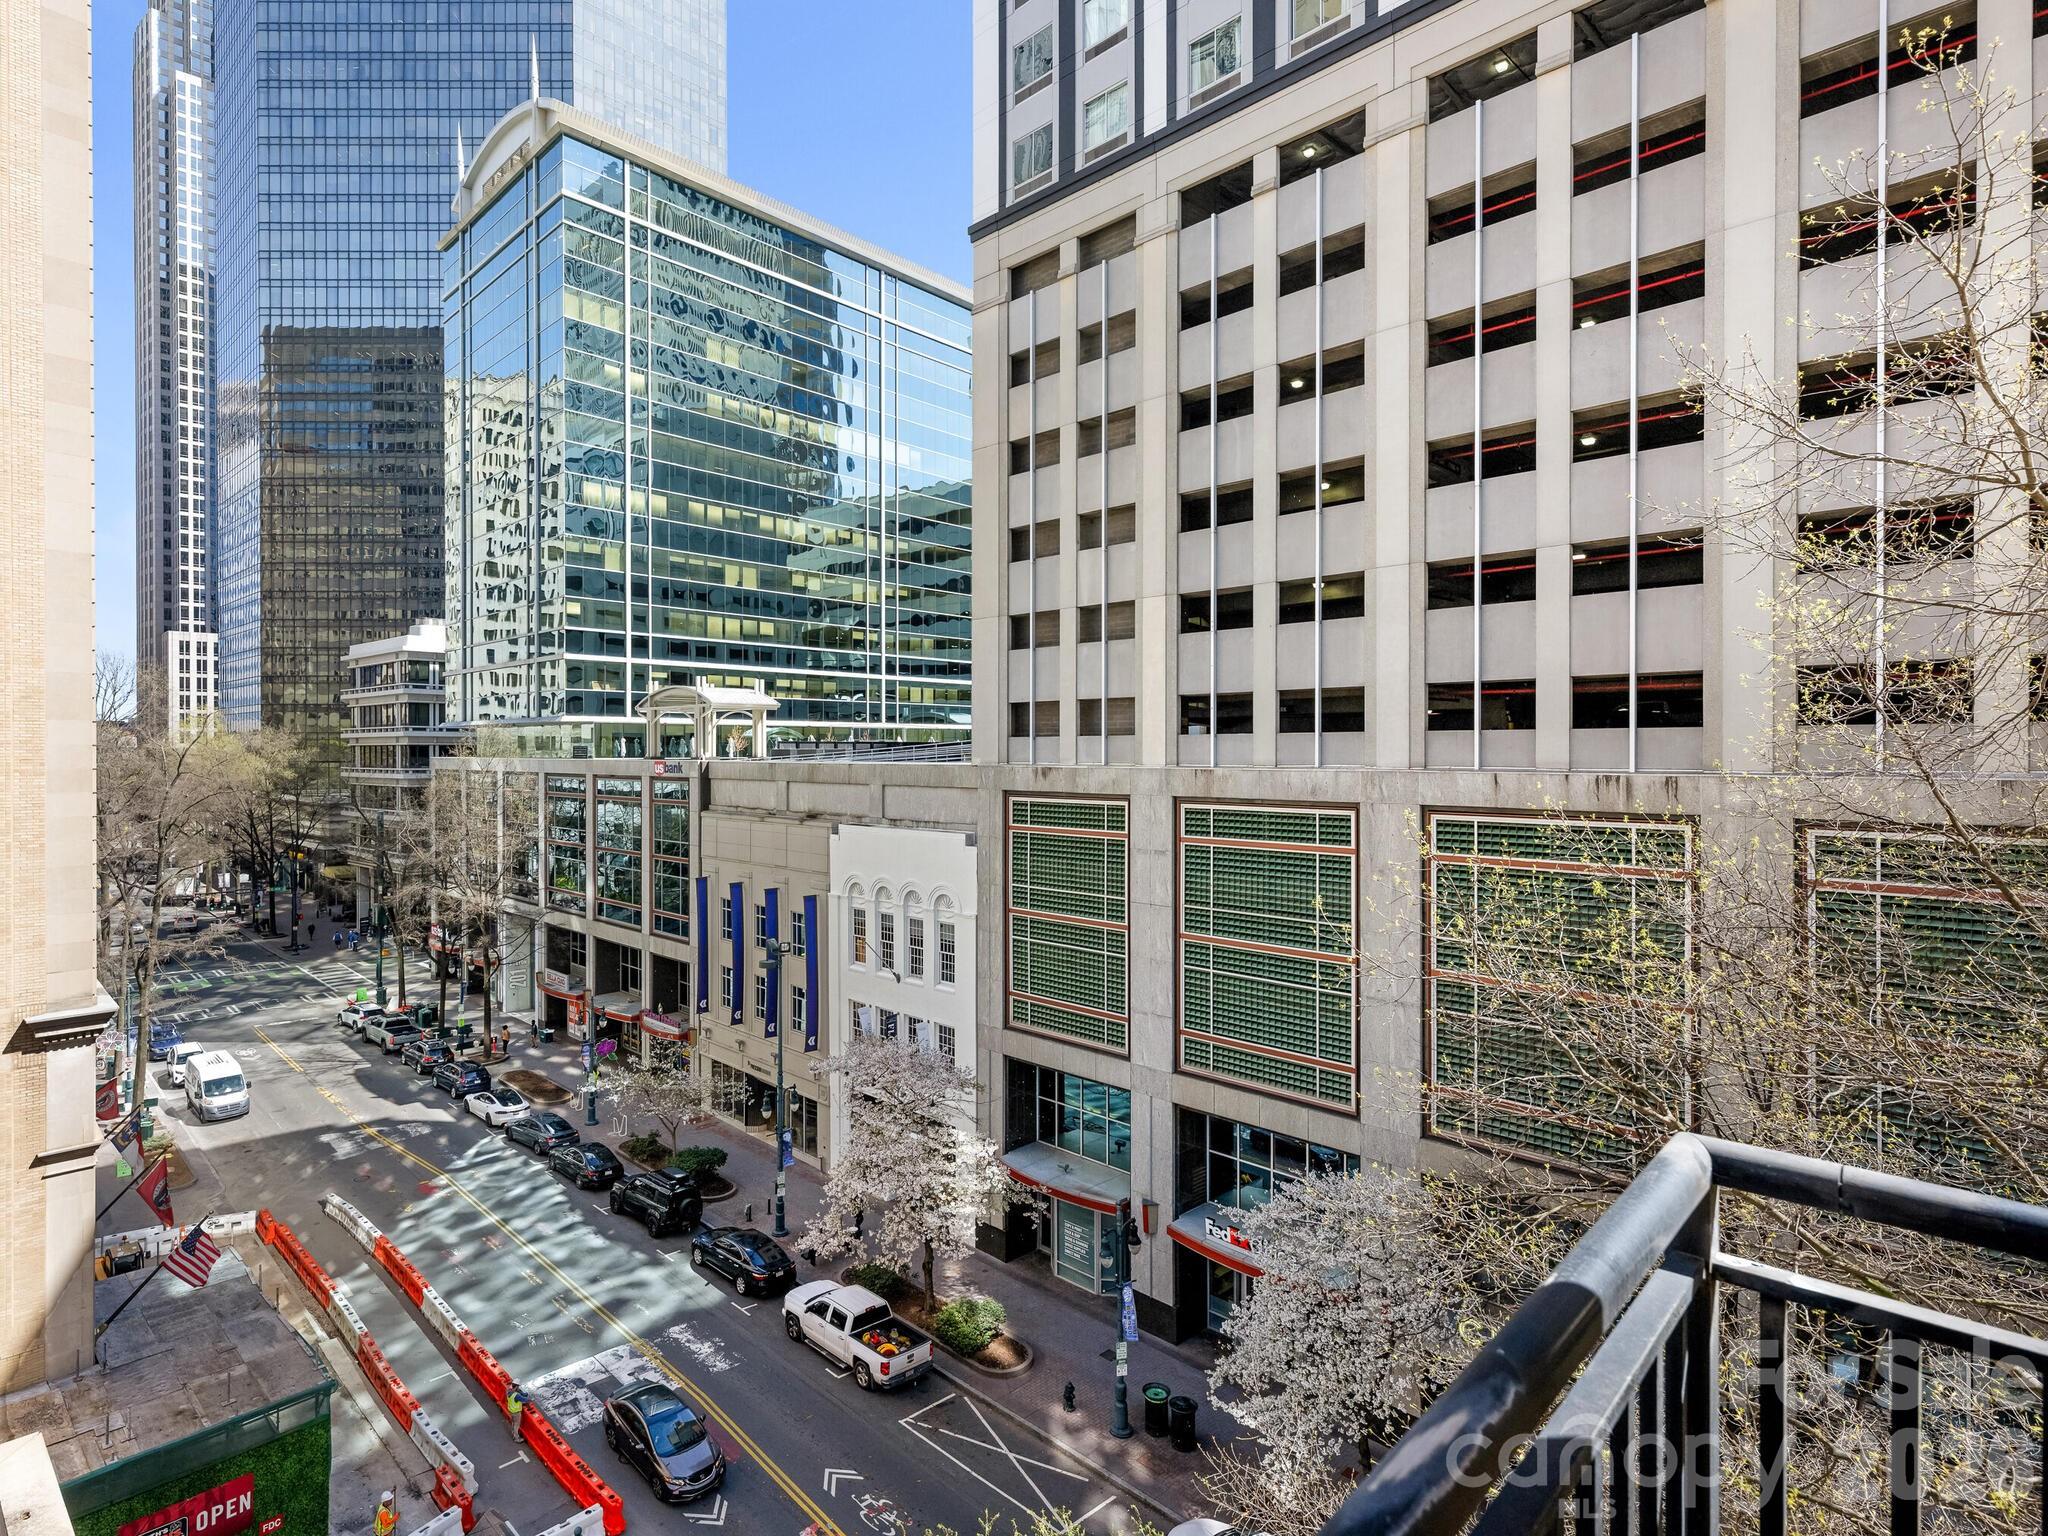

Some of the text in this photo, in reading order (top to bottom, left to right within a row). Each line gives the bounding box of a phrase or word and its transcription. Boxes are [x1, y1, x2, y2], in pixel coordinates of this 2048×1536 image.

[509, 969, 527, 989] 201
[196, 1491, 252, 1531] OPEN
[262, 1517, 282, 1533] FDC
